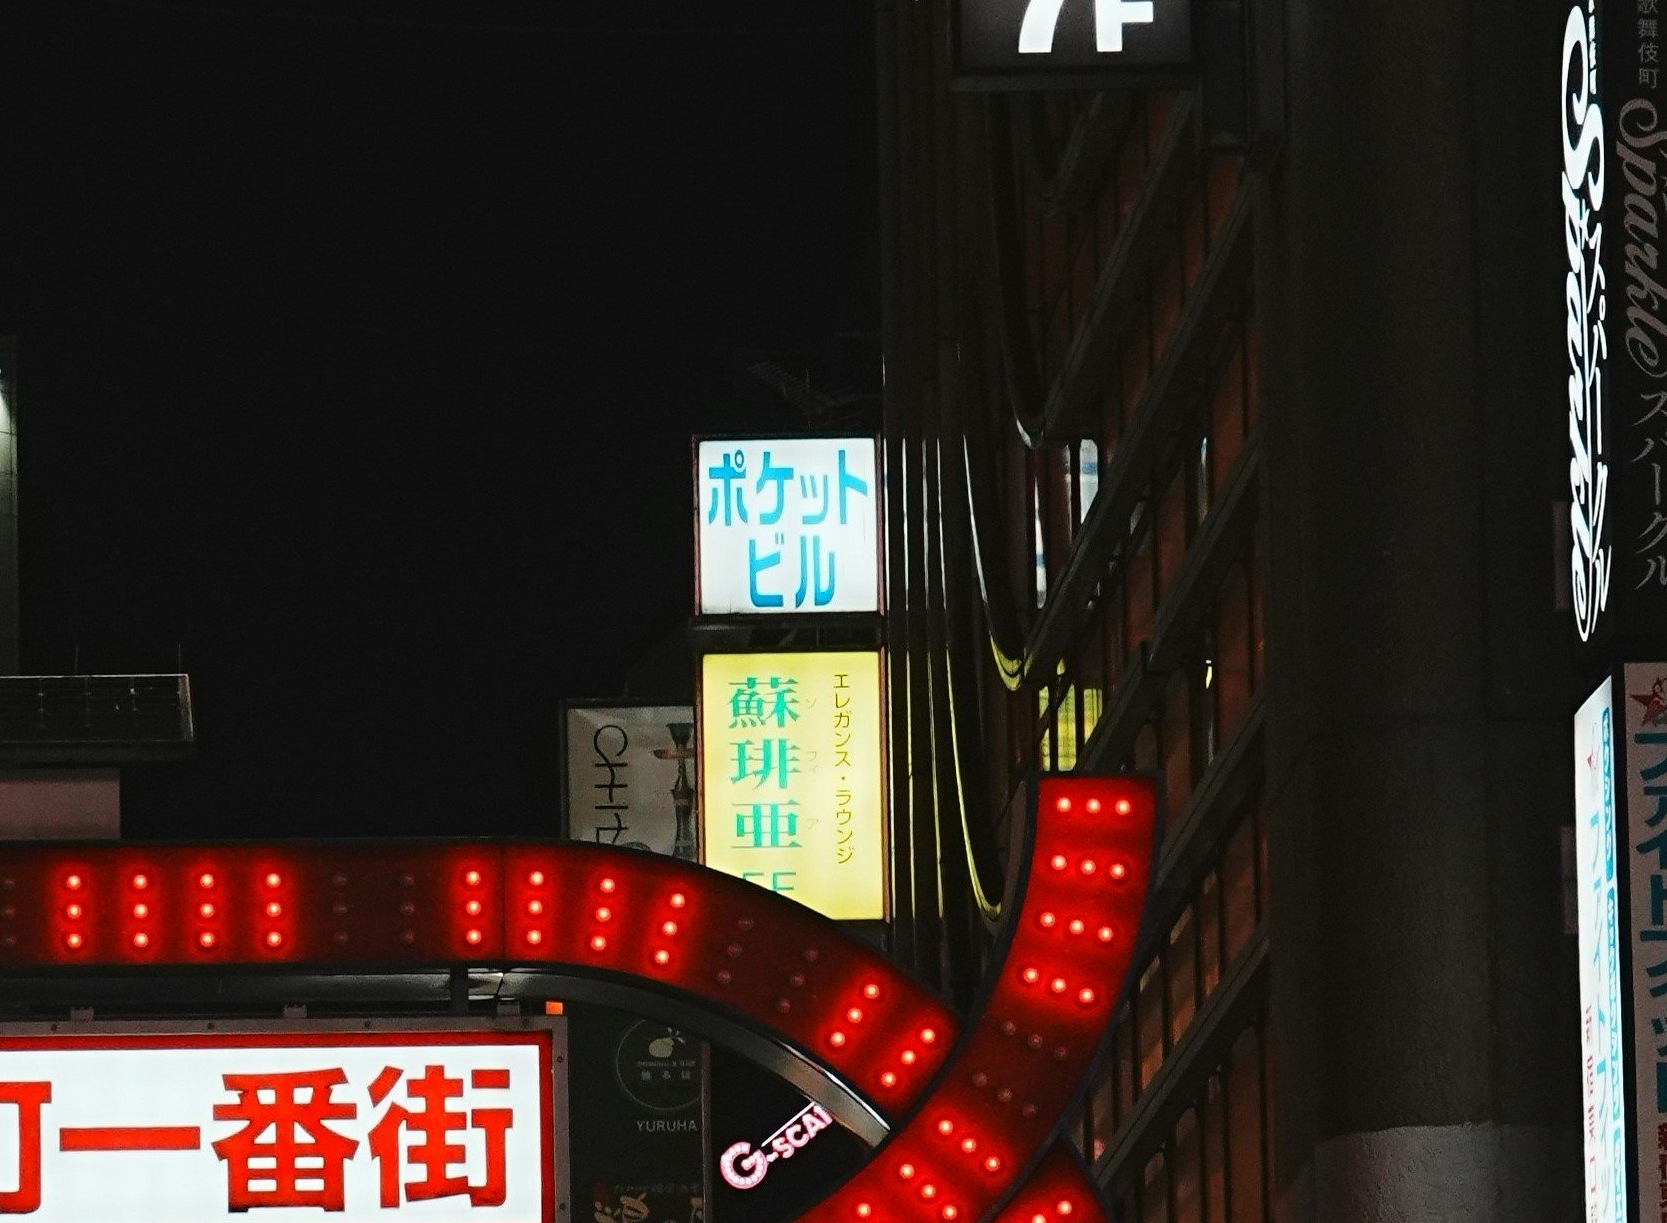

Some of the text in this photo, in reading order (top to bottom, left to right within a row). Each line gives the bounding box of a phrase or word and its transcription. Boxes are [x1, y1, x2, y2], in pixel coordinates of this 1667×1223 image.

[1618, 97, 1667, 379] Sparkle
[707, 449, 869, 528] ポケット
[748, 533, 837, 610] ビル
[728, 676, 804, 850] 蘇琲亜
[832, 673, 856, 865] エレガンス・ラウンジ
[636, 1119, 698, 1133] YURUHA
